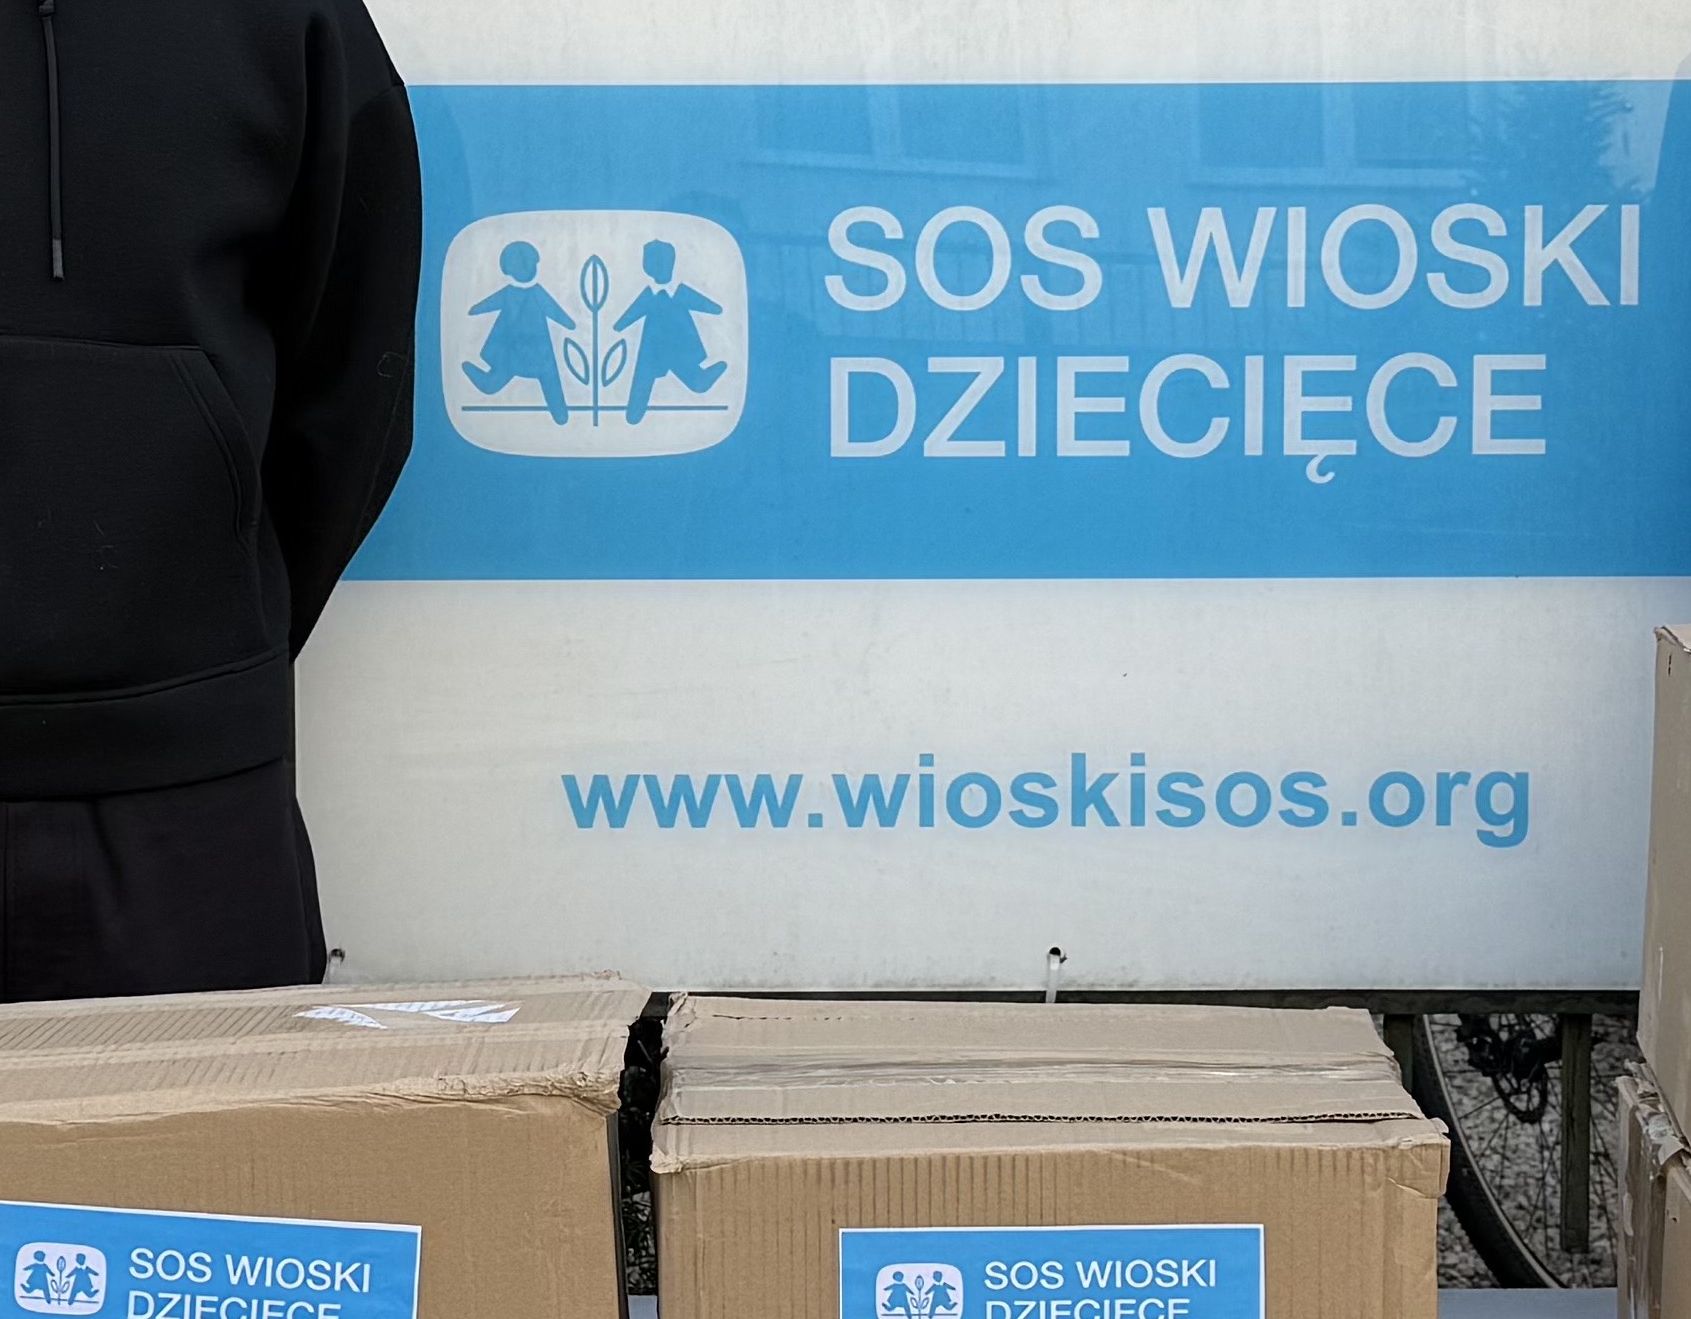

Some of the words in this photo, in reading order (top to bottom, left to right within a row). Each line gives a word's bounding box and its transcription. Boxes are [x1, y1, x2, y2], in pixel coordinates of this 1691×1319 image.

[825, 205, 1103, 311] SOS
[1147, 203, 1639, 309] WIOSKI
[831, 353, 1546, 483] DZIECIĘCE
[560, 752, 1532, 850] www.wioskisos.org
[130, 1248, 211, 1282] SOS
[226, 1255, 370, 1292] WIOSKI
[985, 1261, 1063, 1289] SOS
[1076, 1260, 1215, 1288] WIOSKI
